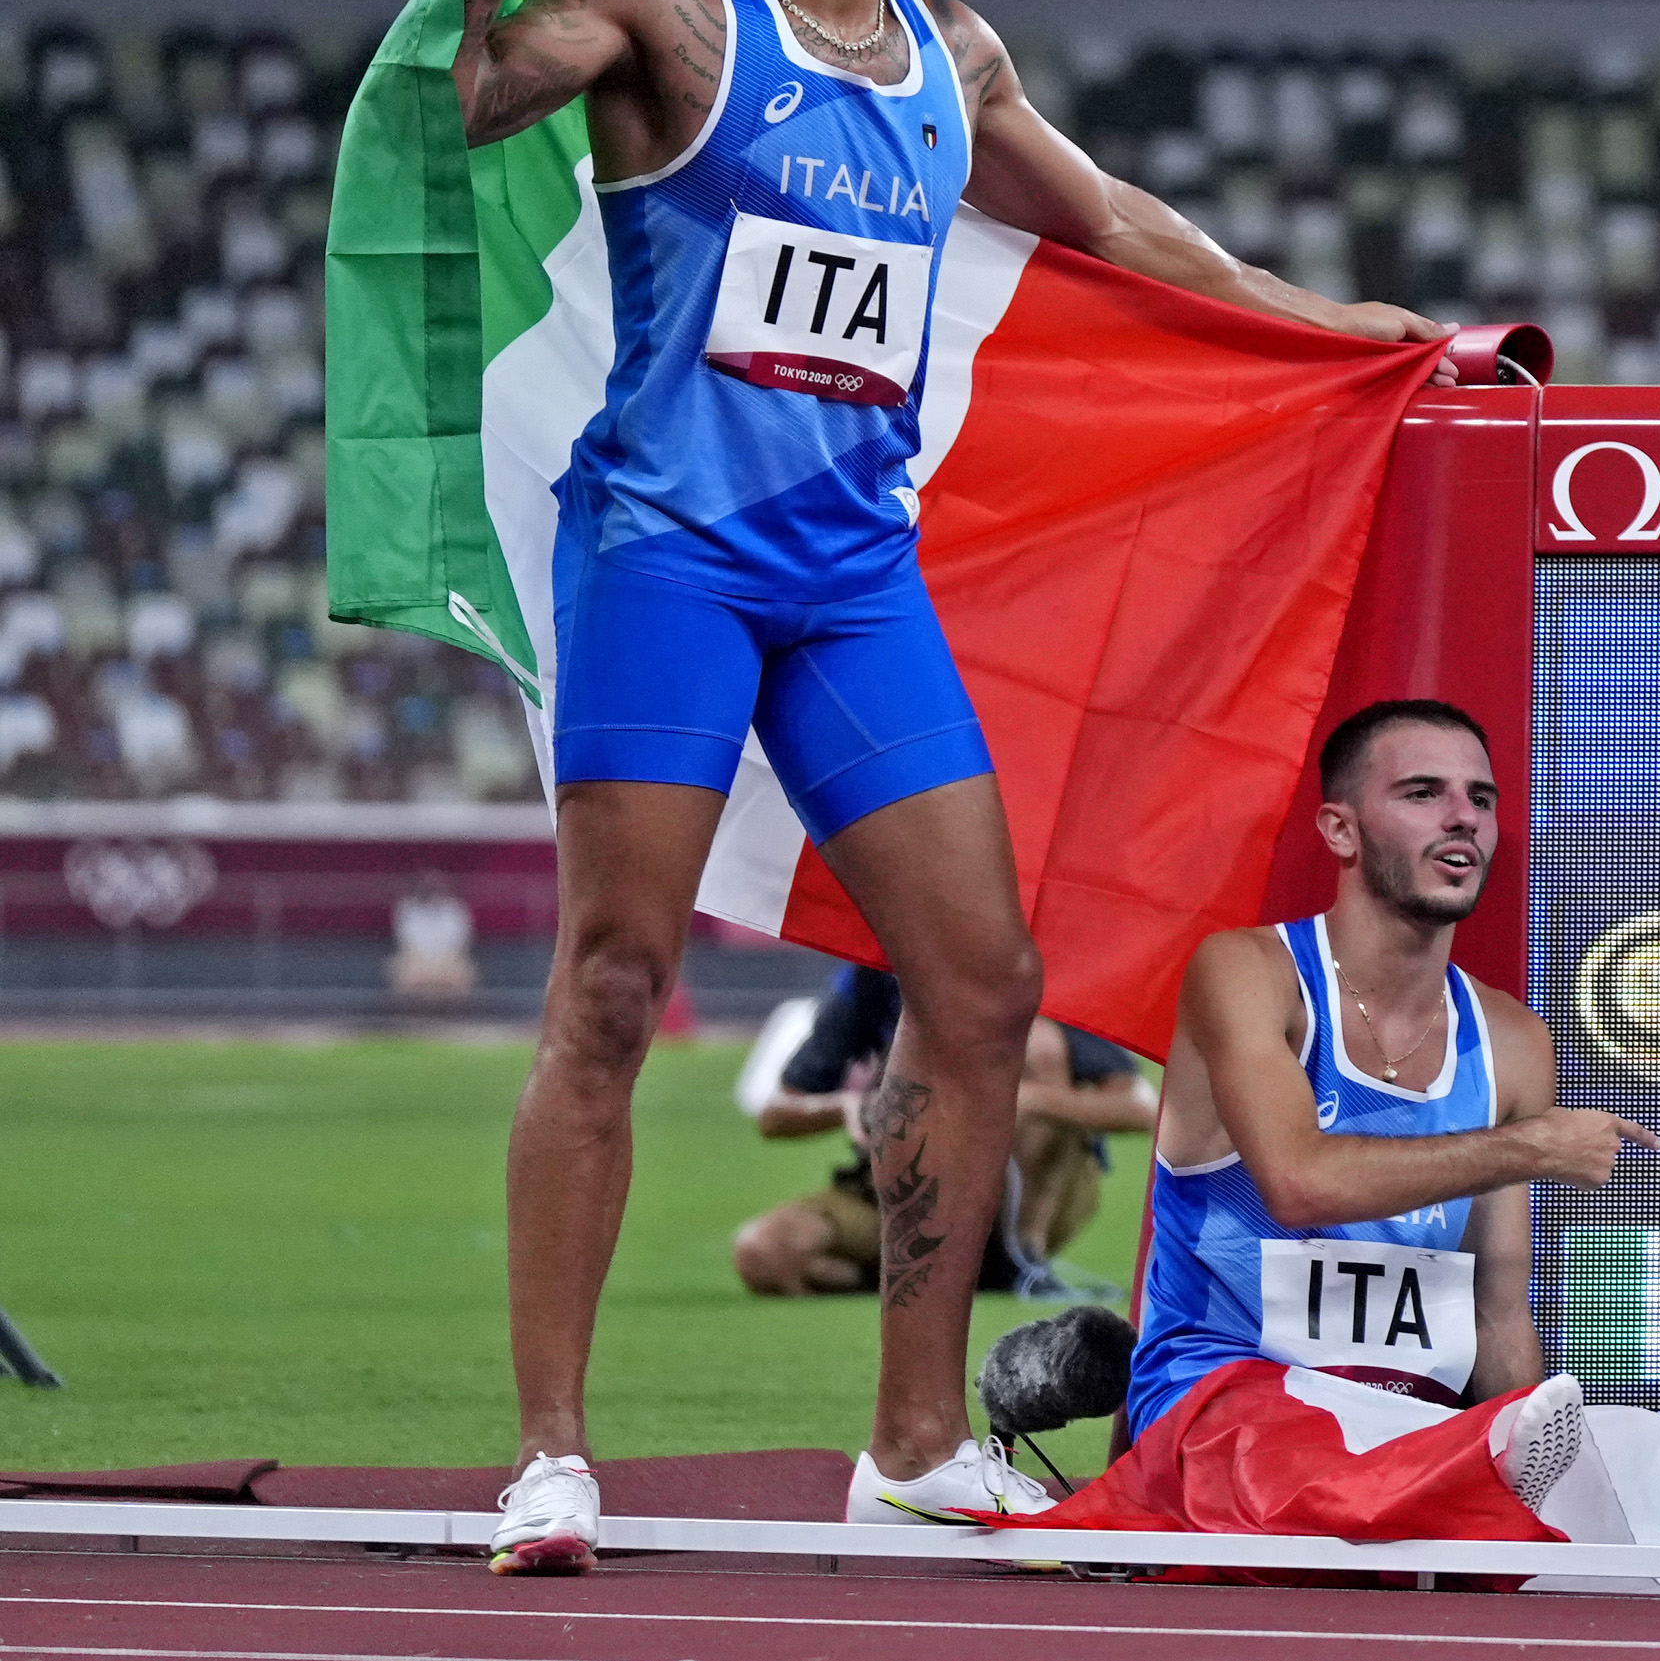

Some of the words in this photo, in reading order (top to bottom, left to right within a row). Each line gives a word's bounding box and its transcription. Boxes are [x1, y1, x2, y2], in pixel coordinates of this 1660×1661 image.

[779, 155, 931, 222] ITALIA
[763, 244, 889, 345] ITA
[773, 364, 807, 380] TOKYO
[808, 371, 832, 385] 2020
[1307, 1259, 1433, 1350] ITA
